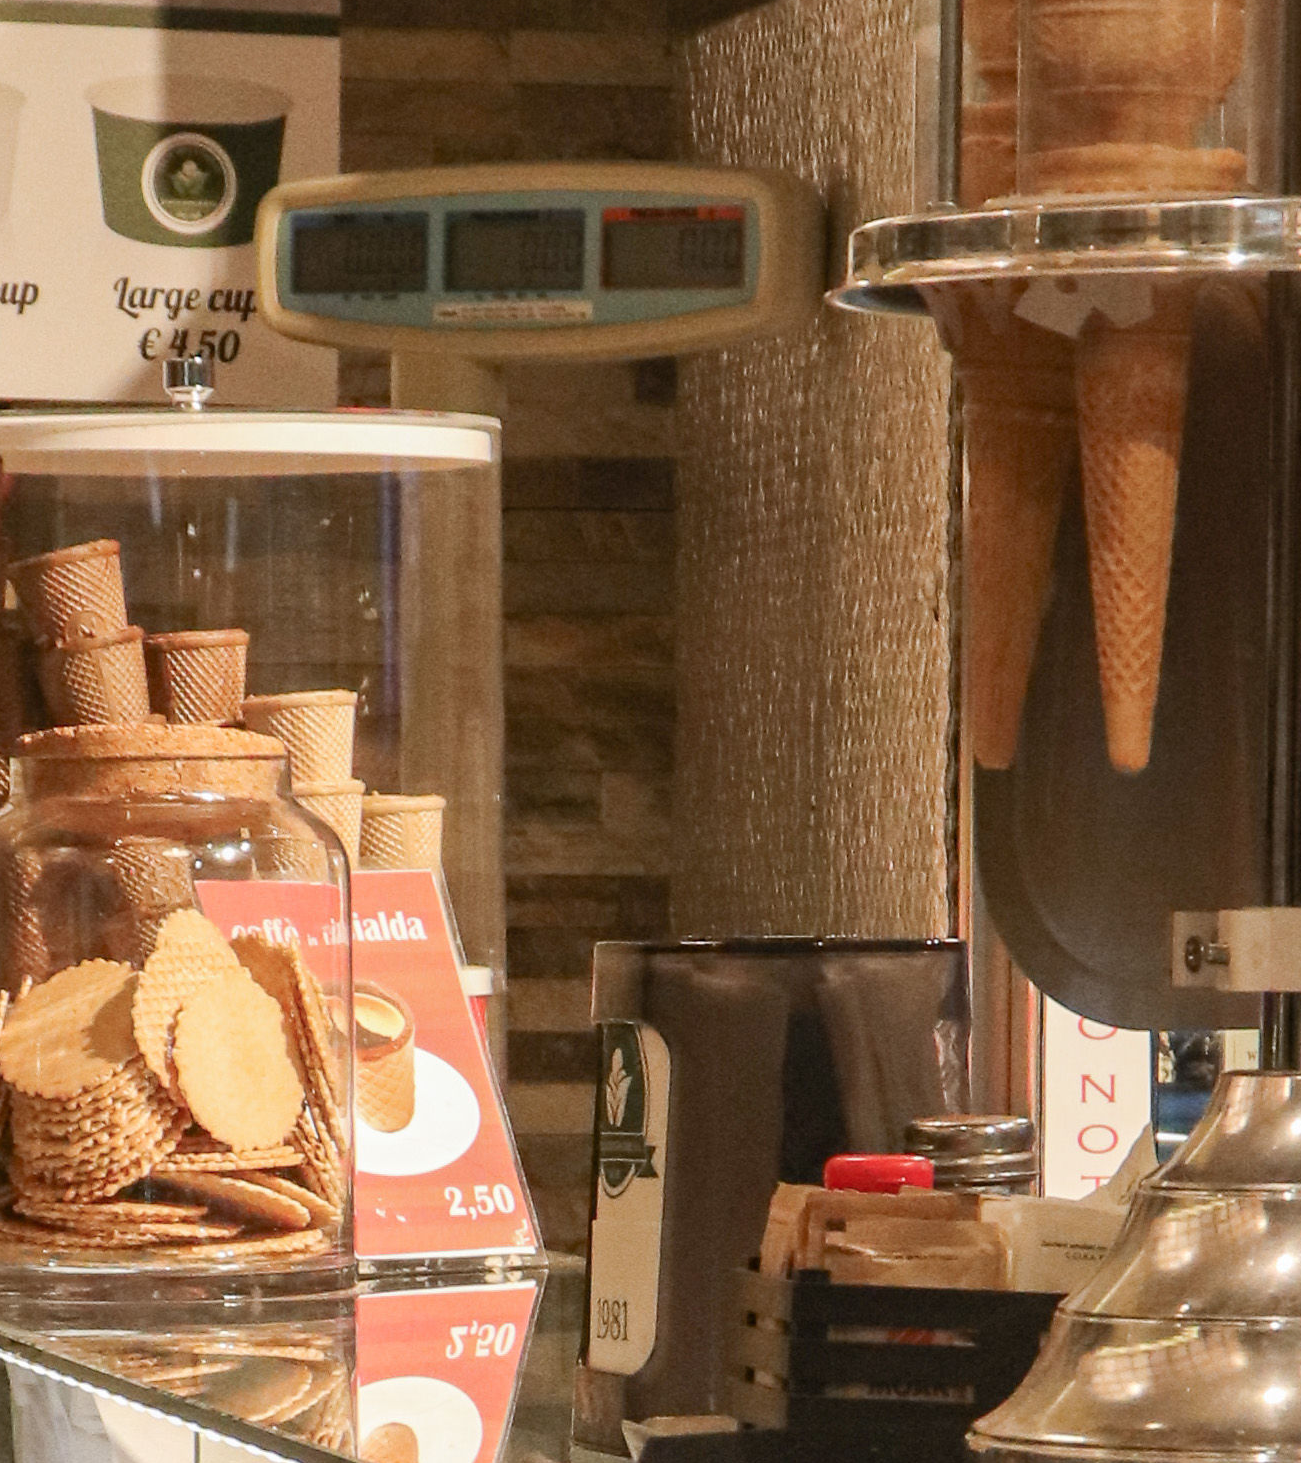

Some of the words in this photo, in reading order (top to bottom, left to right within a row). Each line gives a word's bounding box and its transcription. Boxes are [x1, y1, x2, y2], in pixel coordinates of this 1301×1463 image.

[113, 277, 201, 320] Large
[139, 328, 161, 361] €
[444, 1183, 515, 1220] 2,50
[597, 1298, 629, 1341] 1981
